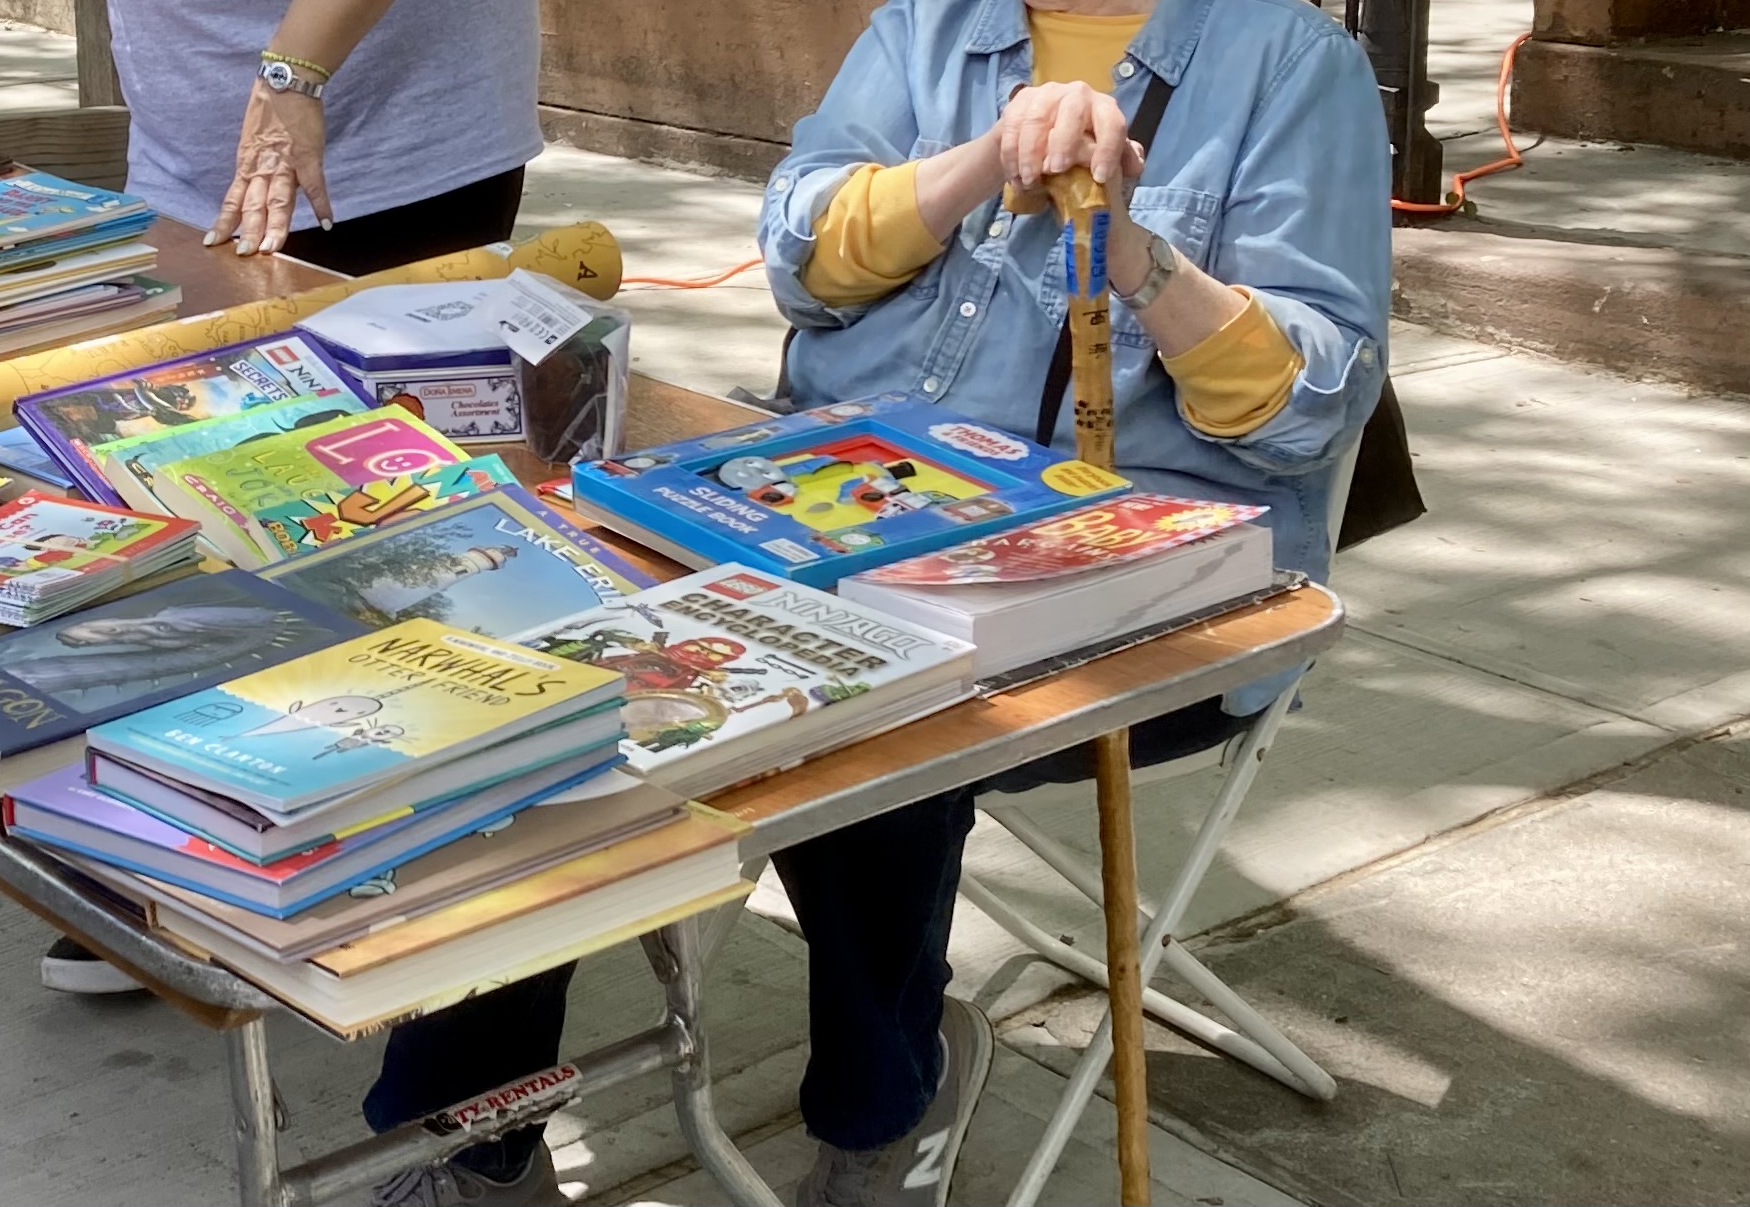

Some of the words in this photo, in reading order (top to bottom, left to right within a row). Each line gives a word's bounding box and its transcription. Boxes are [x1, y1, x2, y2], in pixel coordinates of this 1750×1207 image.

[578, 260, 598, 281] A
[234, 360, 290, 402] SECRETS
[450, 401, 499, 410] Chocolates
[450, 409, 500, 418] Assortment
[950, 426, 1023, 456] THOMAS
[184, 474, 237, 516] CRAIG
[652, 486, 712, 514] PUZZLE
[708, 512, 759, 534] BOOK
[688, 486, 769, 522] SLIDING
[494, 518, 580, 562] LAKE
[1031, 510, 1173, 550] BABY
[658, 600, 860, 677] ENCYCLOPEDIA
[680, 592, 888, 670] CHARACTER
[749, 592, 937, 661] NINJAGO
[348, 654, 426, 682] OTTER
[430, 680, 512, 706] FRIEND
[367, 638, 566, 696] NARWHAL'S
[164, 728, 203, 745] BEN
[204, 742, 288, 774] CLANTON
[487, 1066, 575, 1109] RENTALS
